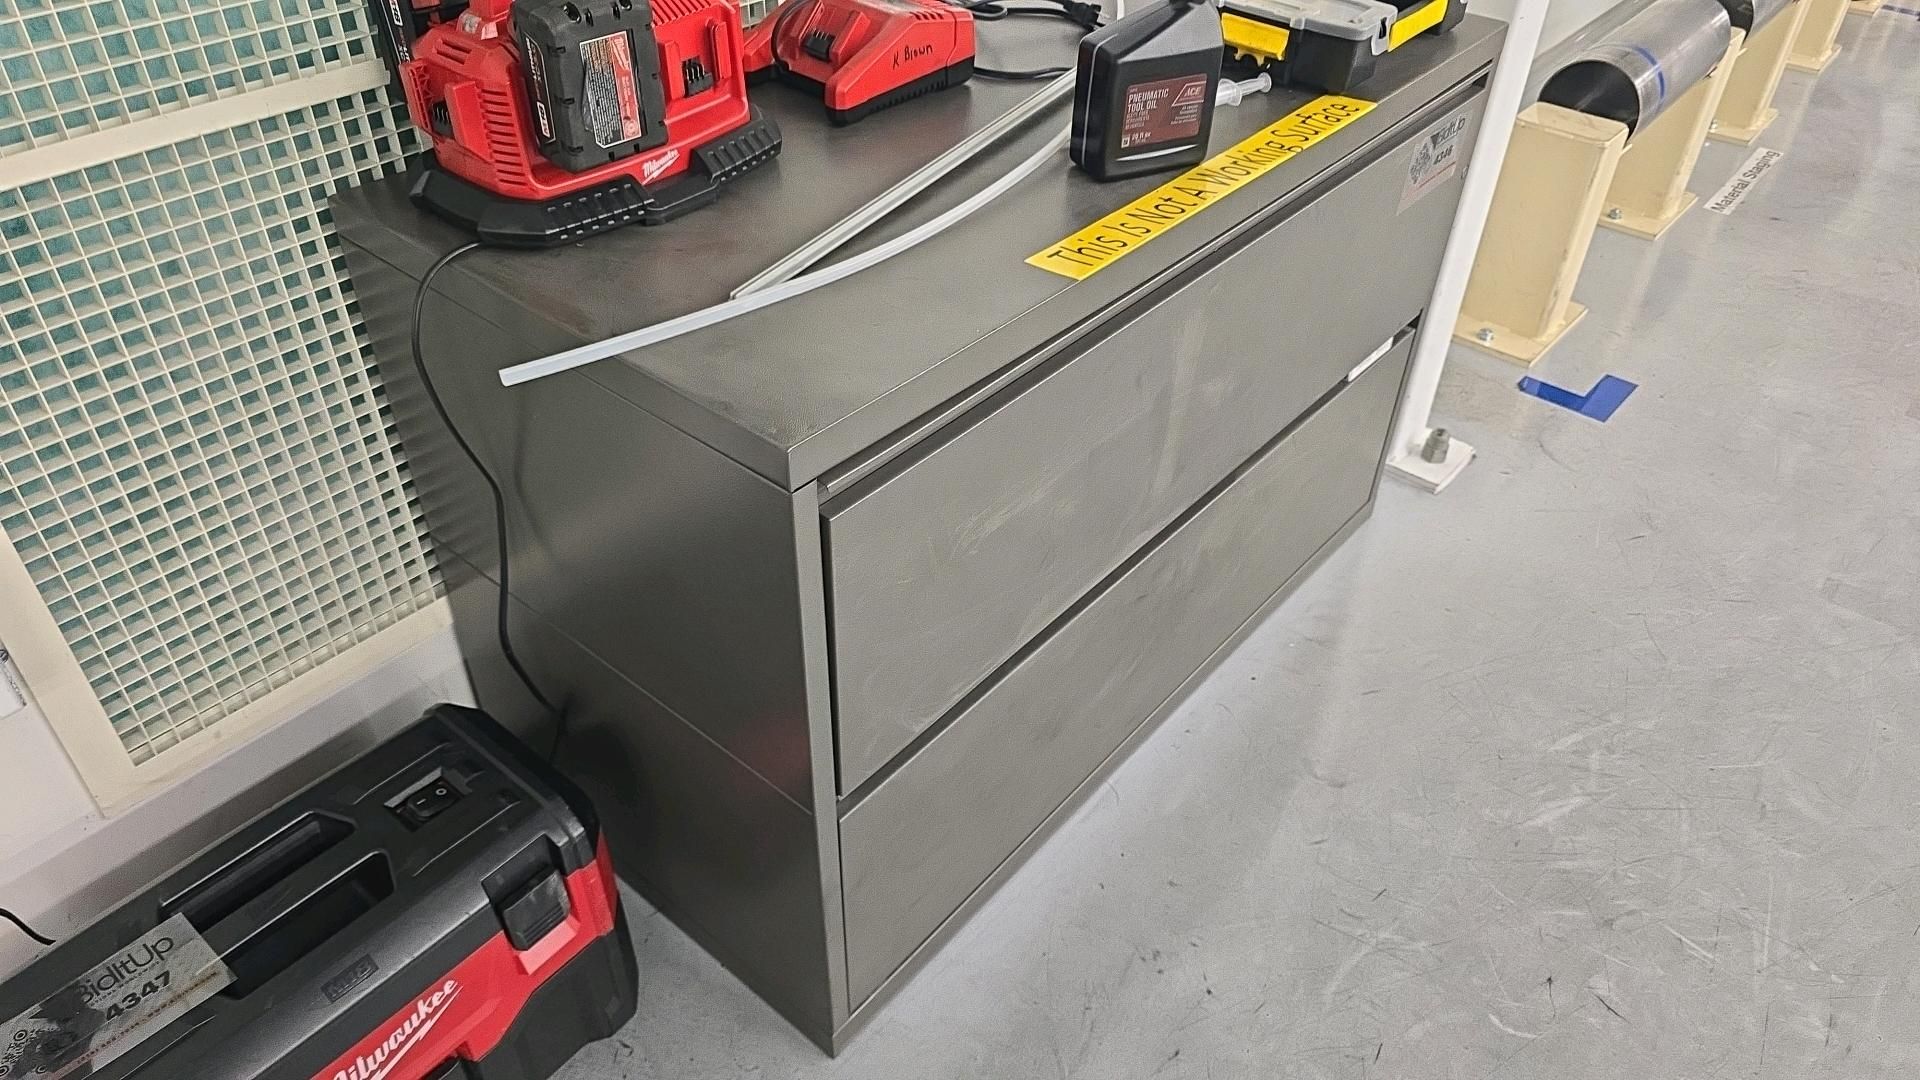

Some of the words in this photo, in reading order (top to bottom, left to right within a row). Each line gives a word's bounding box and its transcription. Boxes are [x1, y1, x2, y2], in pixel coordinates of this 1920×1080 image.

[892, 50, 899, 70] K
[1128, 88, 1170, 104] PNEUMATIC
[1185, 87, 1202, 97] ACE
[1127, 101, 1145, 114] TOOL
[1146, 100, 1158, 111] OIL
[1270, 103, 1360, 142] Surface
[641, 149, 680, 178] Milwaukee
[1187, 140, 1304, 186] Working
[1172, 185, 1218, 200] A
[1710, 179, 1751, 212] Material
[1742, 150, 1781, 180] Staging
[1125, 196, 1198, 225] Not
[1101, 222, 1152, 238] Is
[1046, 236, 1128, 267] This
[106, 970, 171, 1021] 4347
